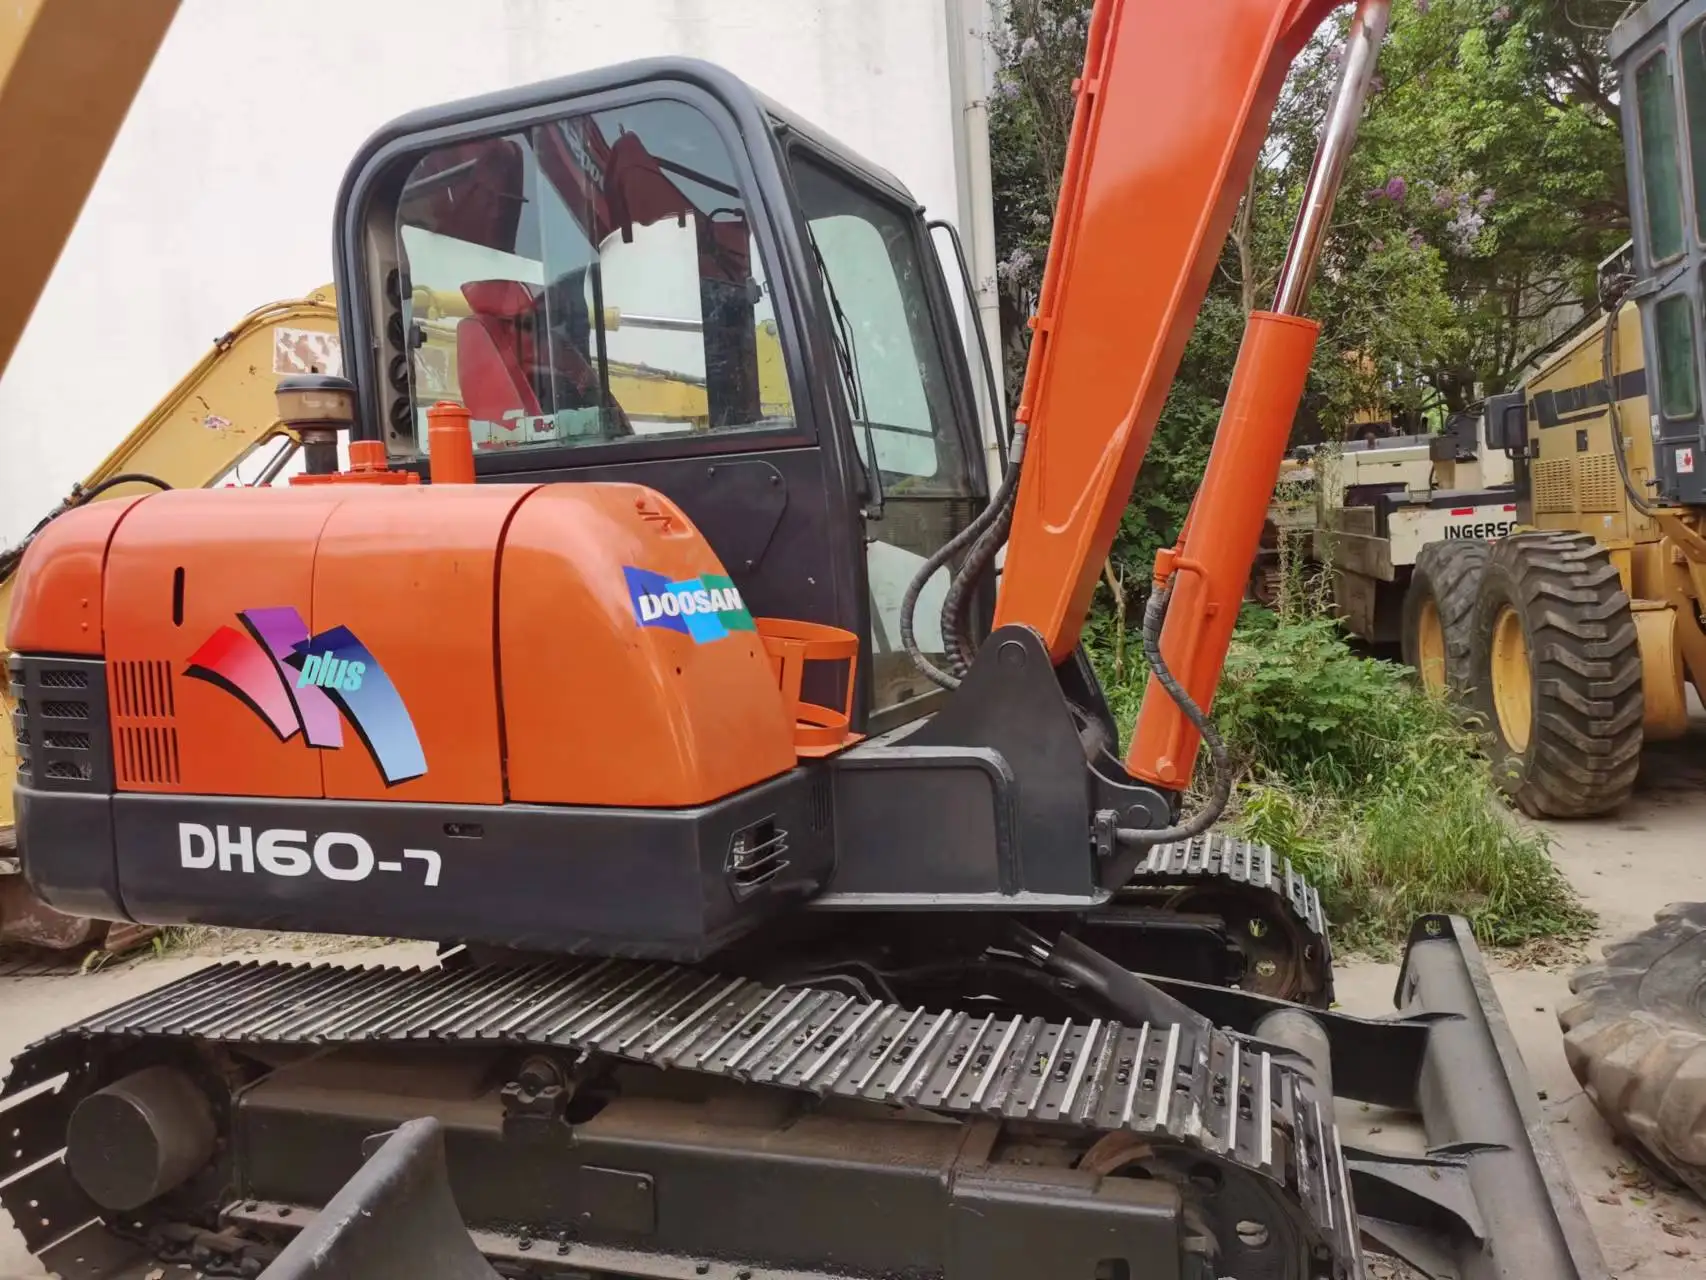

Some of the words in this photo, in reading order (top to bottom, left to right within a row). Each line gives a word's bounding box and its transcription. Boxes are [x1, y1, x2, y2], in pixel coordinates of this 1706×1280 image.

[638, 587, 742, 621] DOOSAN
[296, 650, 366, 691] plus
[179, 822, 442, 887] DH60-7
